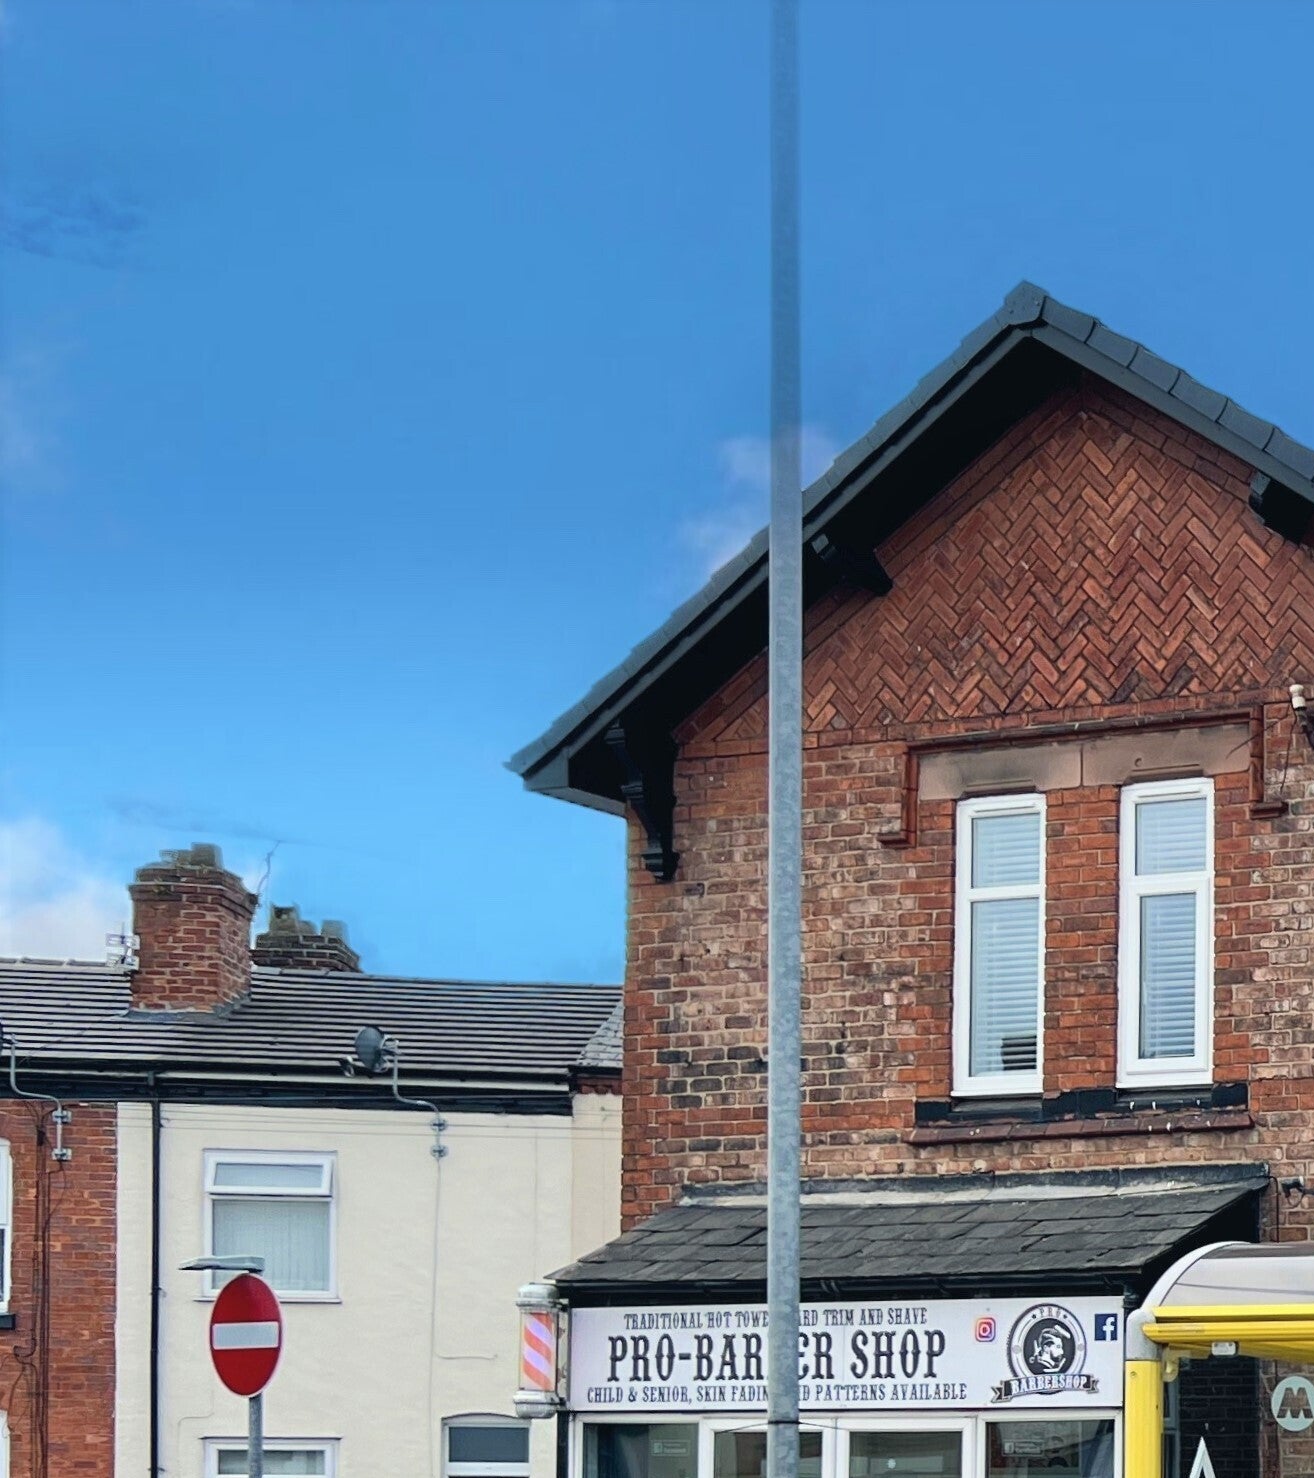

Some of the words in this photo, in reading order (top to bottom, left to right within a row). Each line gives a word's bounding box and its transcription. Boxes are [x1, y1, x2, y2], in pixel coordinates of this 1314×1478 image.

[624, 1312, 703, 1330] TRADITIONAL
[706, 1311, 732, 1328] HOT
[735, 1310, 768, 1328] TOWE
[823, 1309, 854, 1326] TRIM
[859, 1308, 884, 1325] AND
[887, 1307, 928, 1325] SHAVE
[607, 1331, 835, 1382] PRO-BARER
[850, 1329, 946, 1379] SHOP
[587, 1387, 623, 1404] CHILD
[628, 1386, 638, 1402] &
[642, 1386, 692, 1405] SENIOR,
[697, 1385, 726, 1402] SKIN
[731, 1385, 768, 1402] FADIN
[816, 1384, 885, 1401] PATTERNS
[891, 1383, 967, 1401] AVAILABLE
[1011, 1374, 1088, 1396] BARBERSHOP
